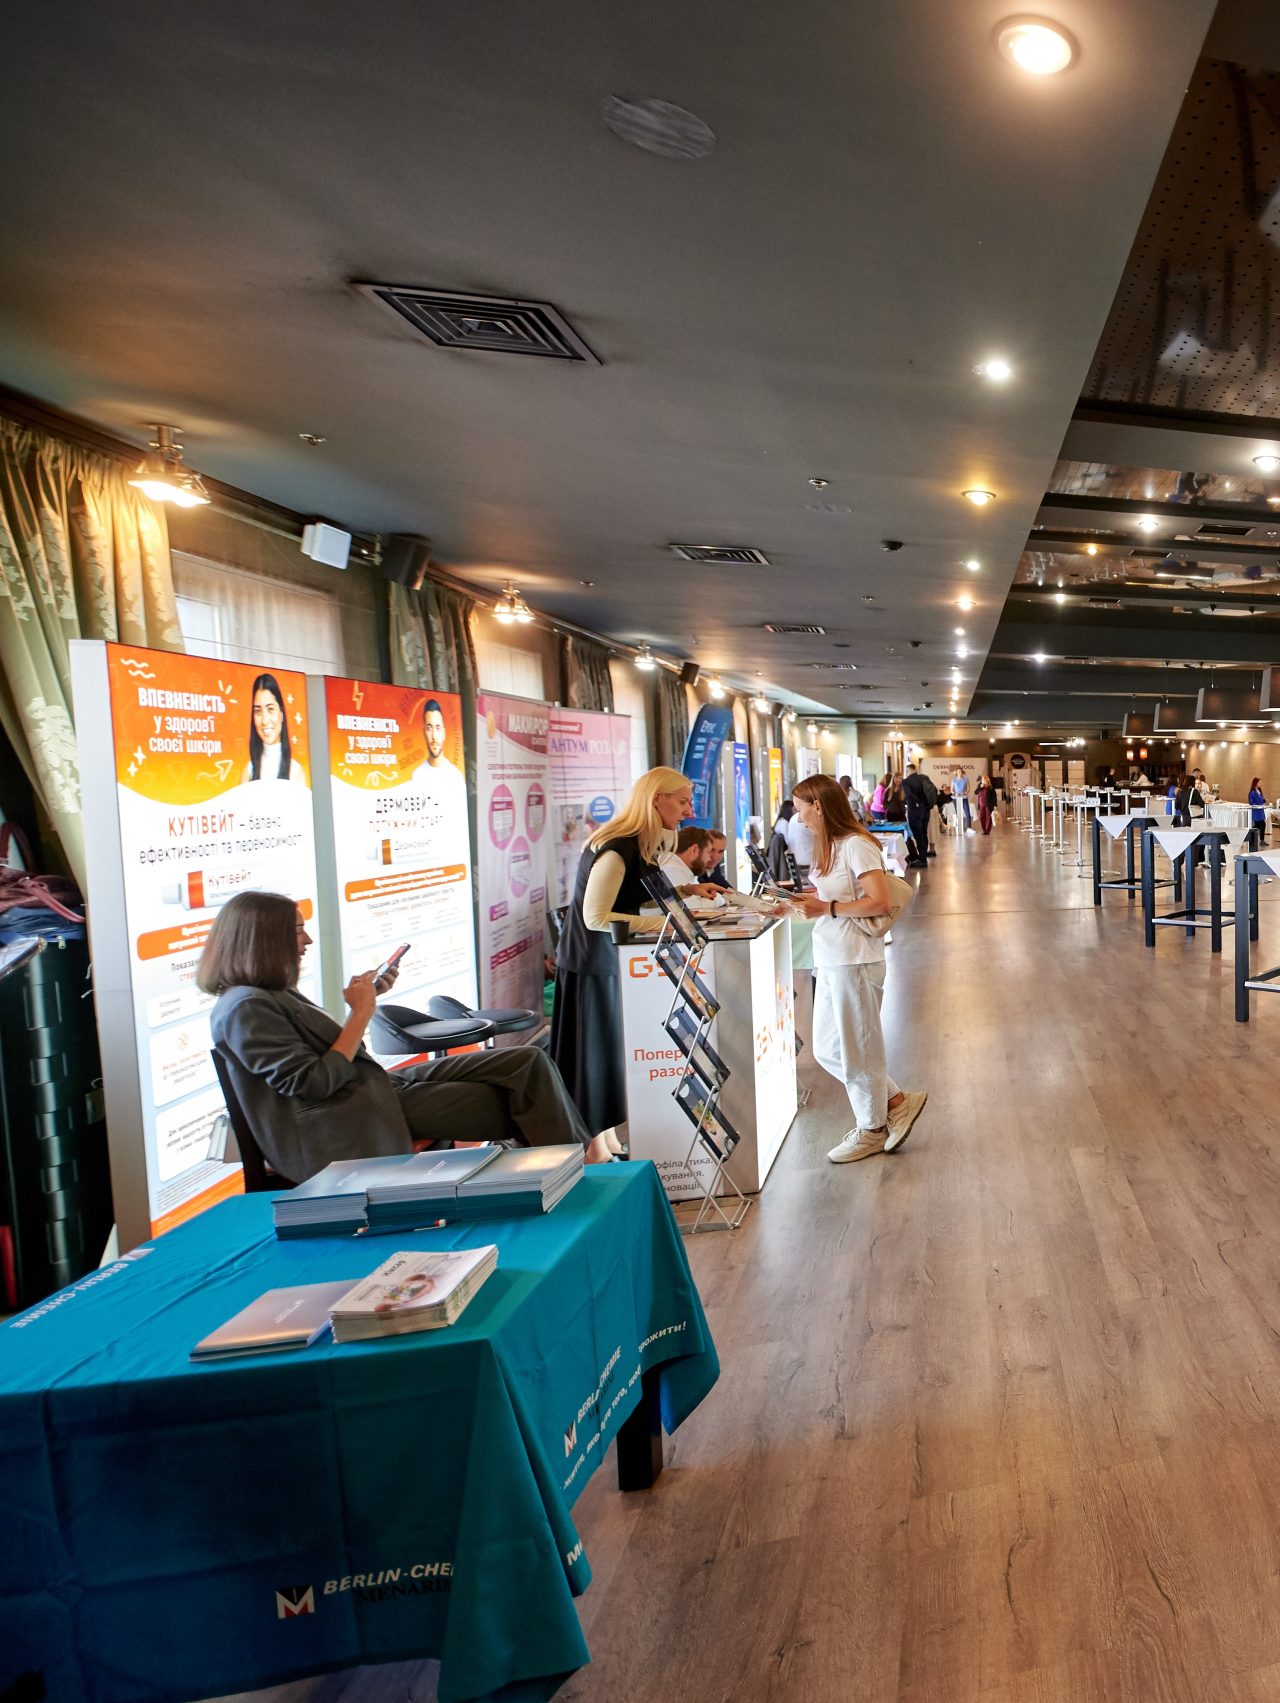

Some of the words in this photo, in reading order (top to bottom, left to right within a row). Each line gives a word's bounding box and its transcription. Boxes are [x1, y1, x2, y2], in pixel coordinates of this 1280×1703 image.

[138, 687, 226, 713] ВПЕВНЕНІСТЬ
[153, 715, 162, 734] у
[149, 735, 183, 753] своєї
[186, 736, 222, 756] шкіри
[168, 809, 235, 837] КУТІВЕЙТ
[655, 1157, 713, 1171] офілатика.
[323, 1562, 454, 1595] BERLIN-CHE
